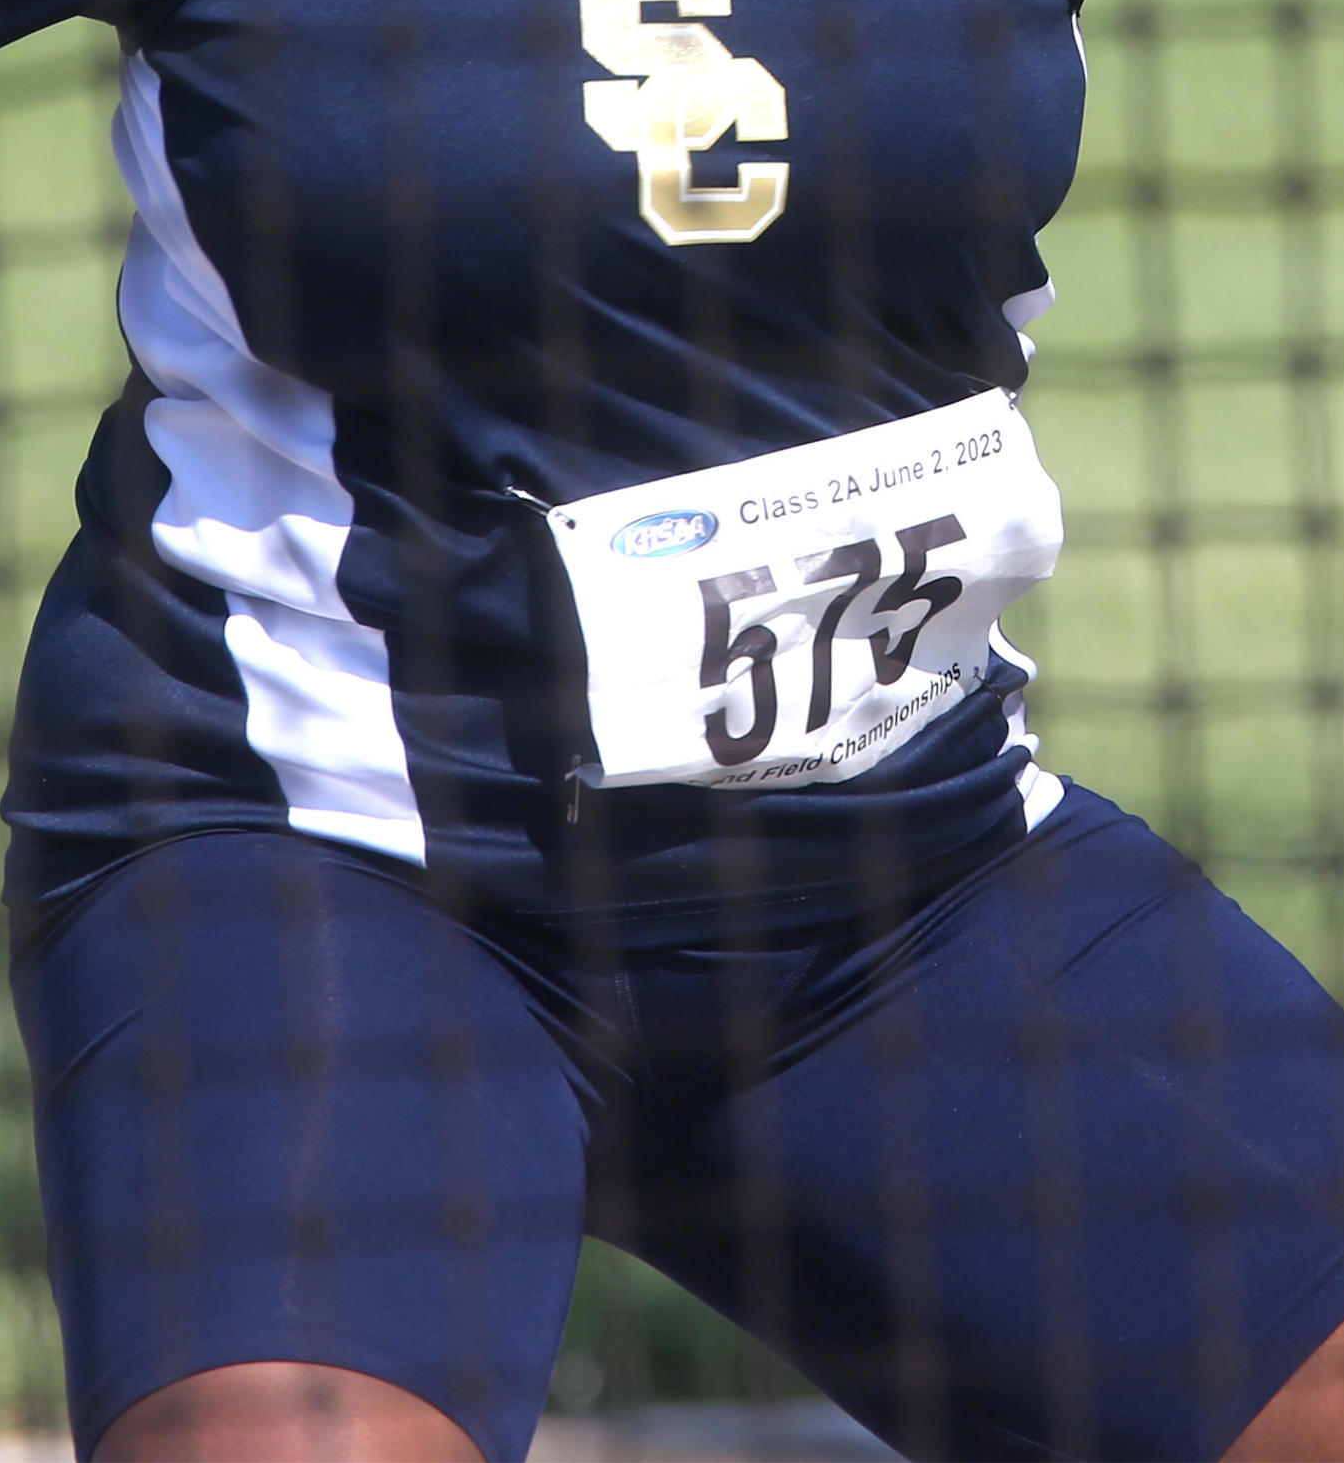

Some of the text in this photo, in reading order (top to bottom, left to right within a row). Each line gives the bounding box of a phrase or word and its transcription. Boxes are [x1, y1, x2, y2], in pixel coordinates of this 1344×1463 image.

[739, 490, 819, 525] Class
[828, 475, 862, 504] 2A
[869, 461, 924, 493] June
[955, 429, 1003, 467] 2023
[698, 513, 967, 767] 575
[760, 754, 824, 783] Field
[829, 660, 962, 765] Championships
